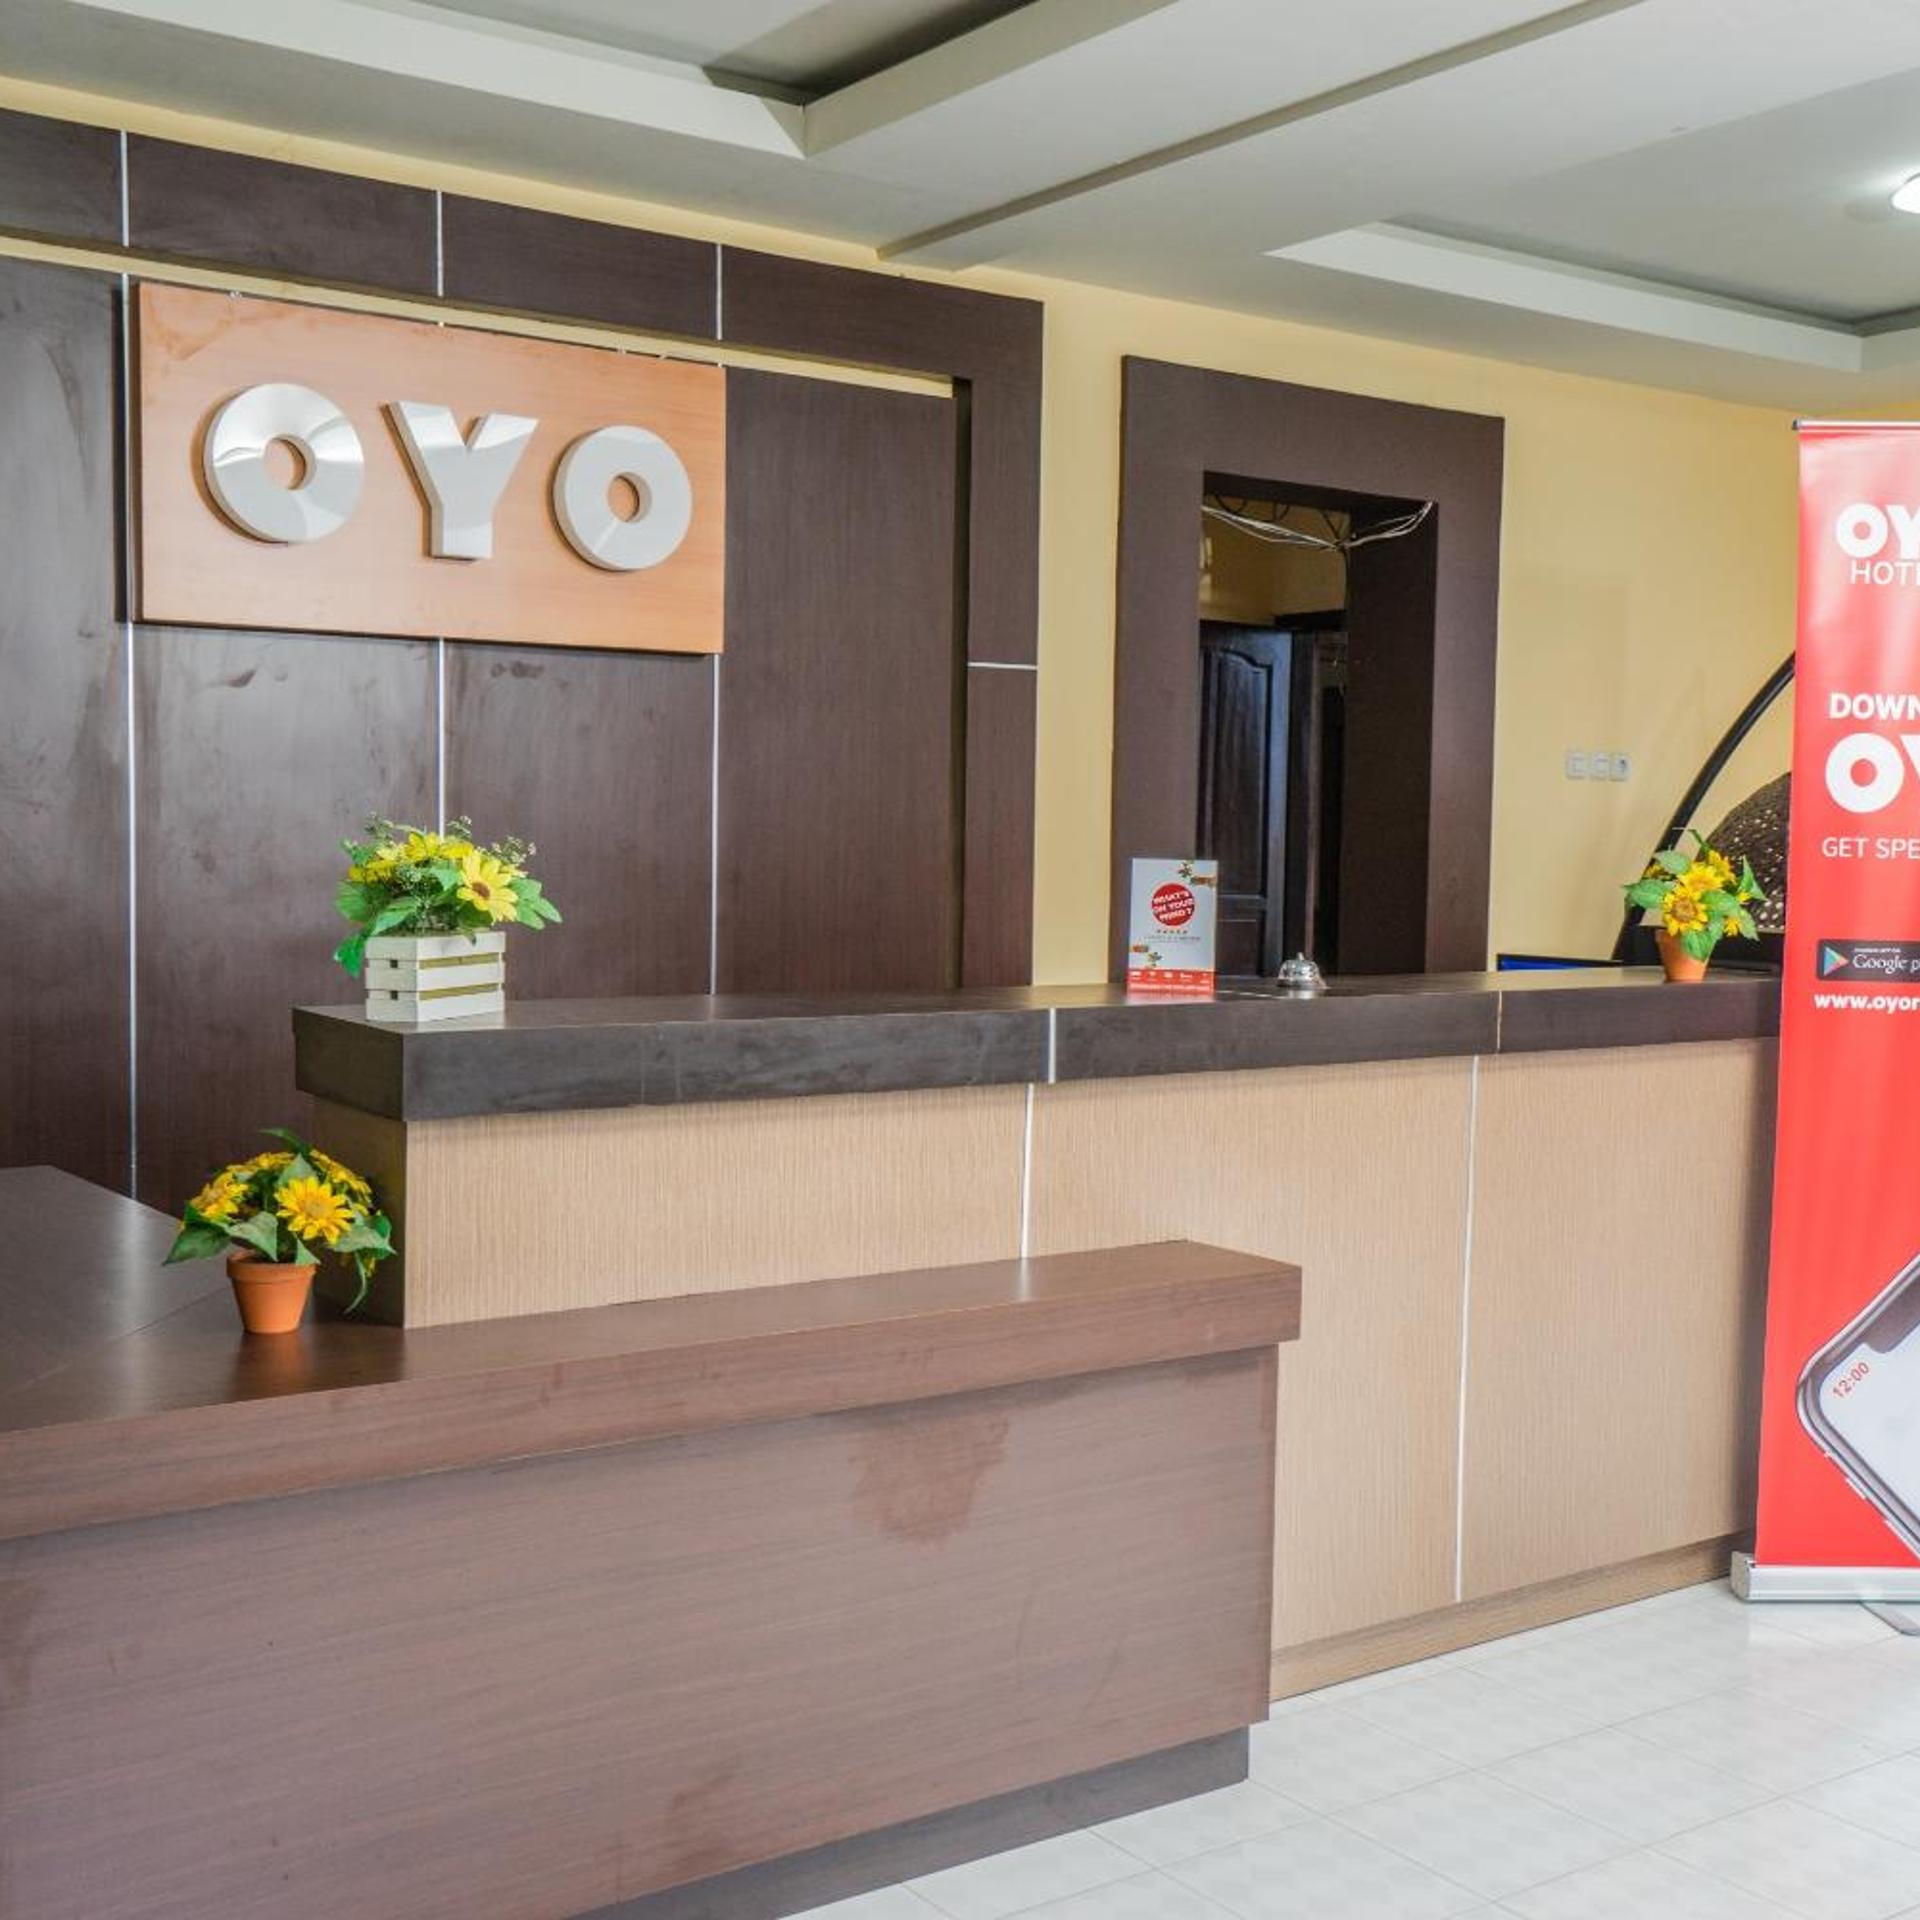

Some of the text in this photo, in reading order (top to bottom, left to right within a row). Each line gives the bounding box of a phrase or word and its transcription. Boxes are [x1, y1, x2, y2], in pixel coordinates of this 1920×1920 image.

[203, 383, 692, 571] OYO
[1825, 732, 1920, 814] O
[1822, 836, 1869, 858] GET
[1852, 953, 1907, 974] Google
[1833, 1362, 1869, 1398] 12:00
